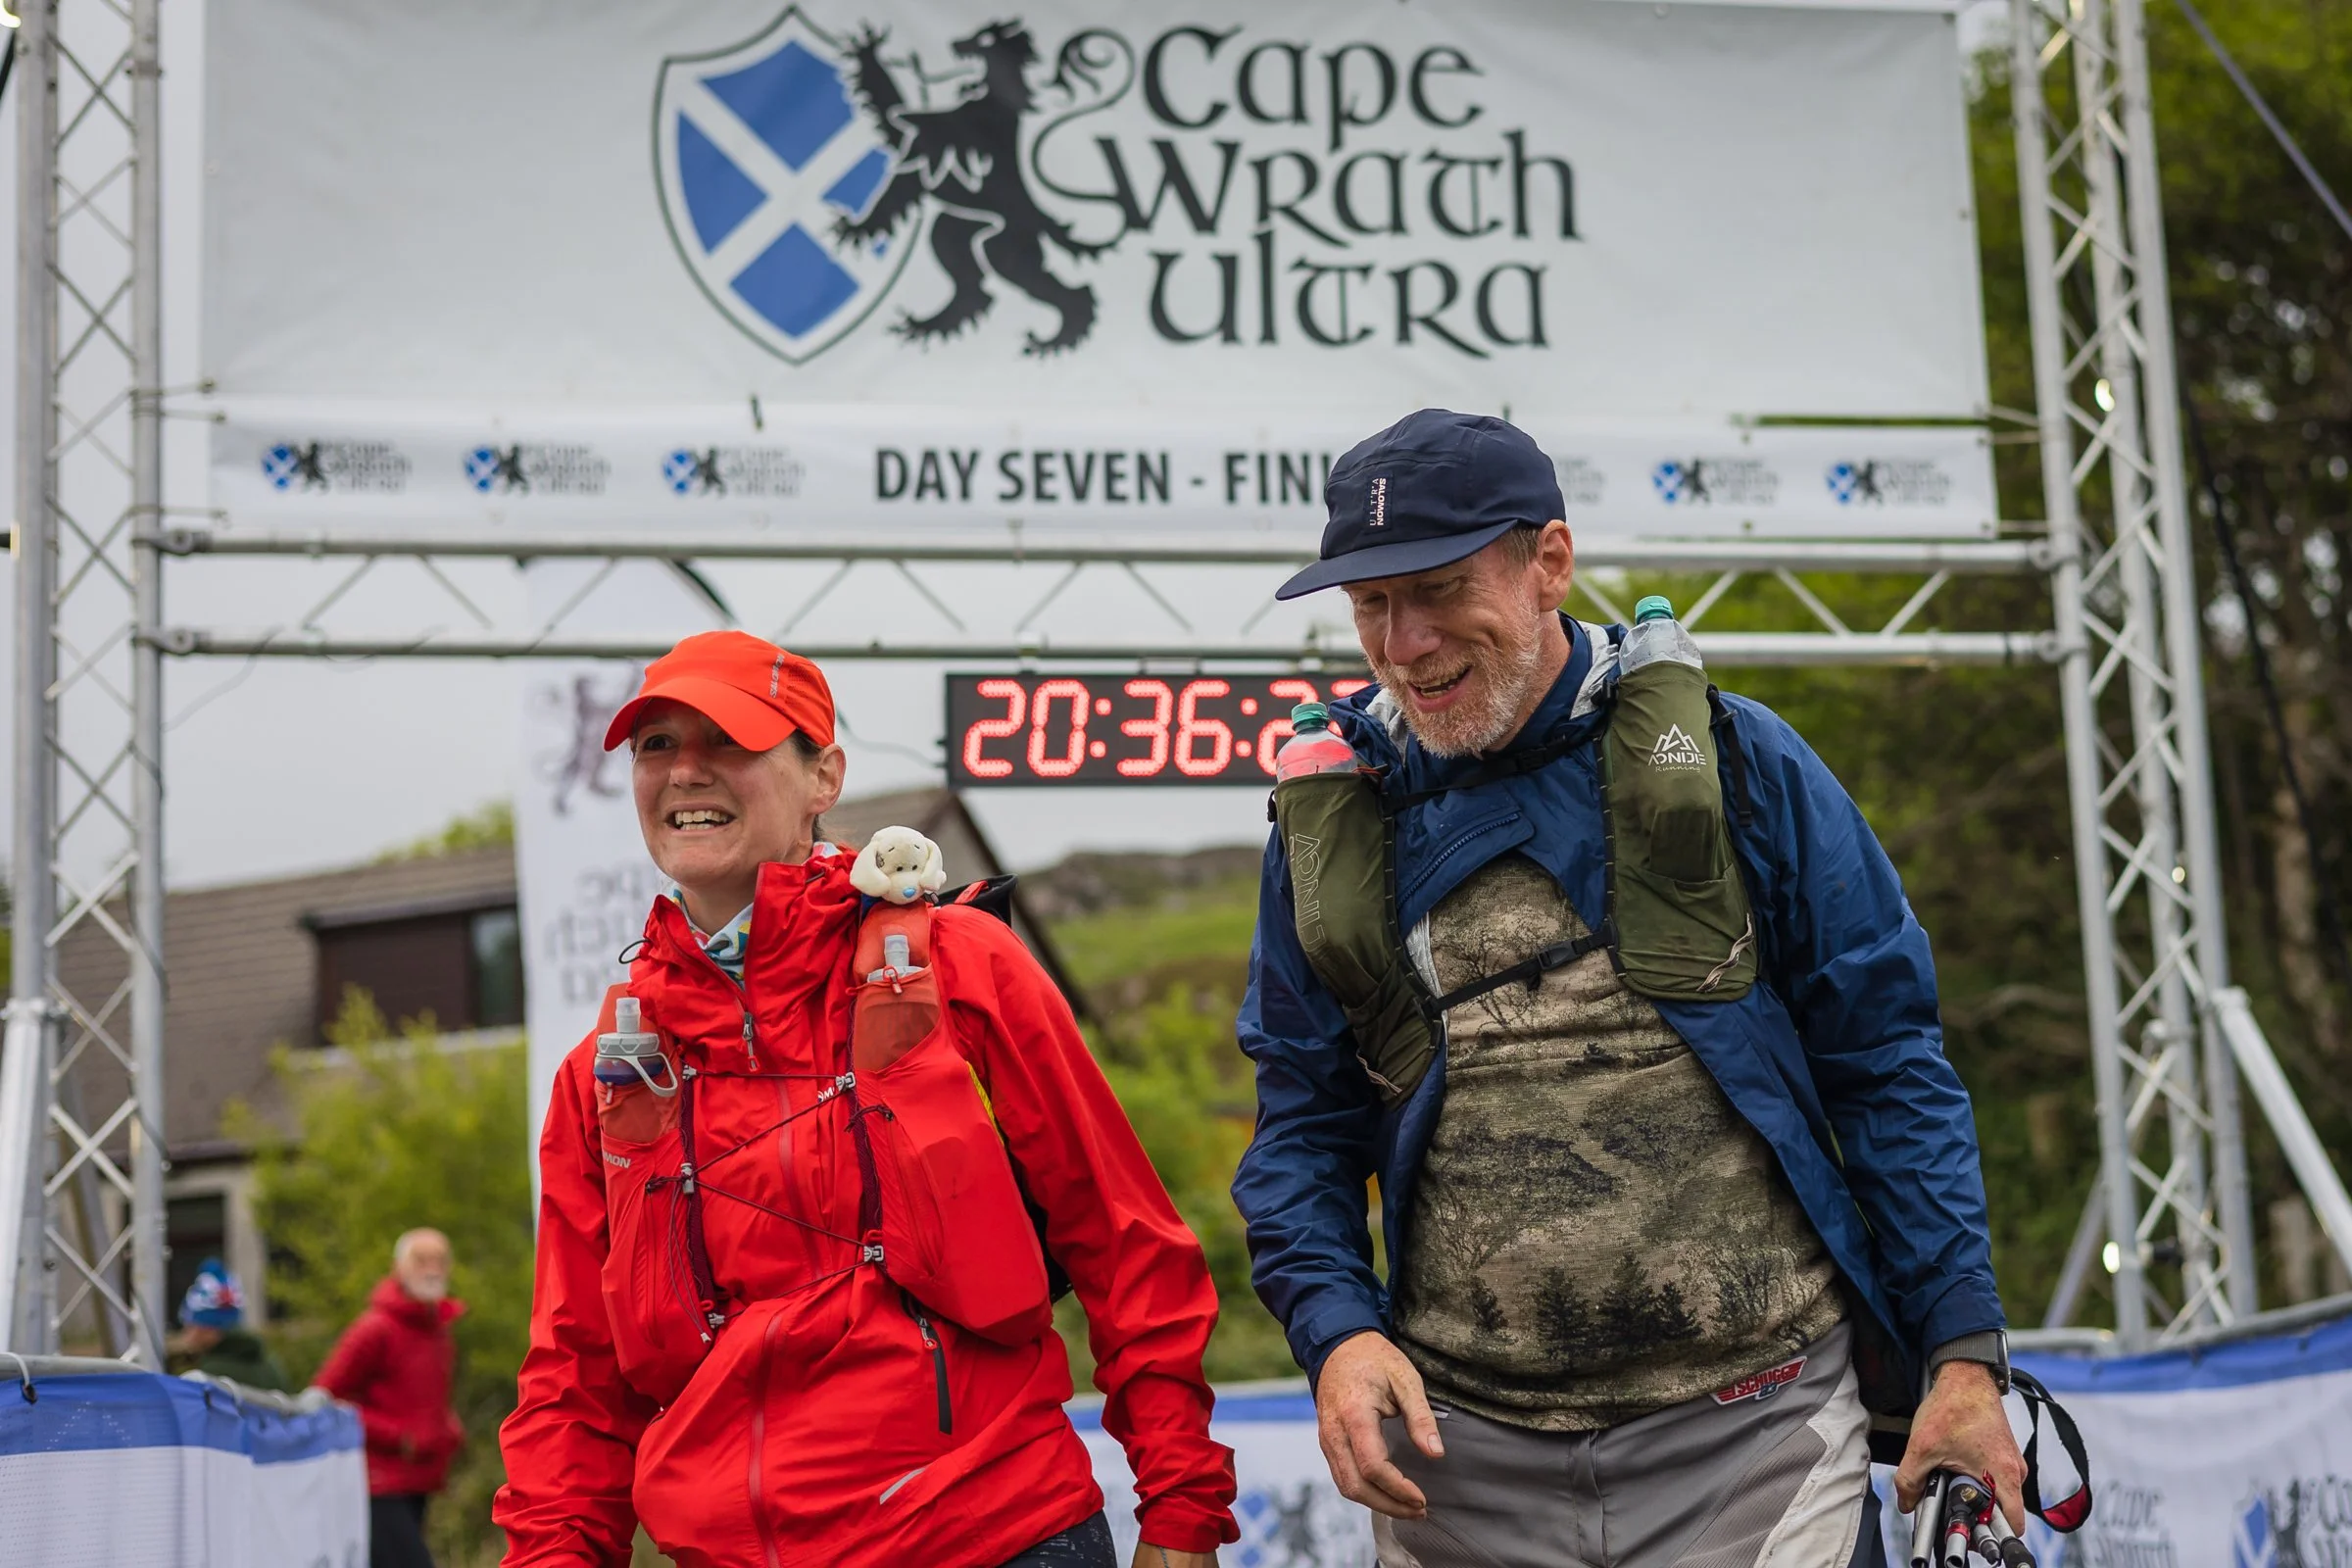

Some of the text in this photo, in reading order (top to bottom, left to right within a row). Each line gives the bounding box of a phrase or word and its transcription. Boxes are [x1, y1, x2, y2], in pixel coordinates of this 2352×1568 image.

[875, 447, 978, 504] DAY
[999, 449, 1170, 504] SEVEN
[1225, 452, 1332, 505] FINI
[1376, 477, 1387, 525] SALOMON
[962, 679, 1372, 778] 20:36:2
